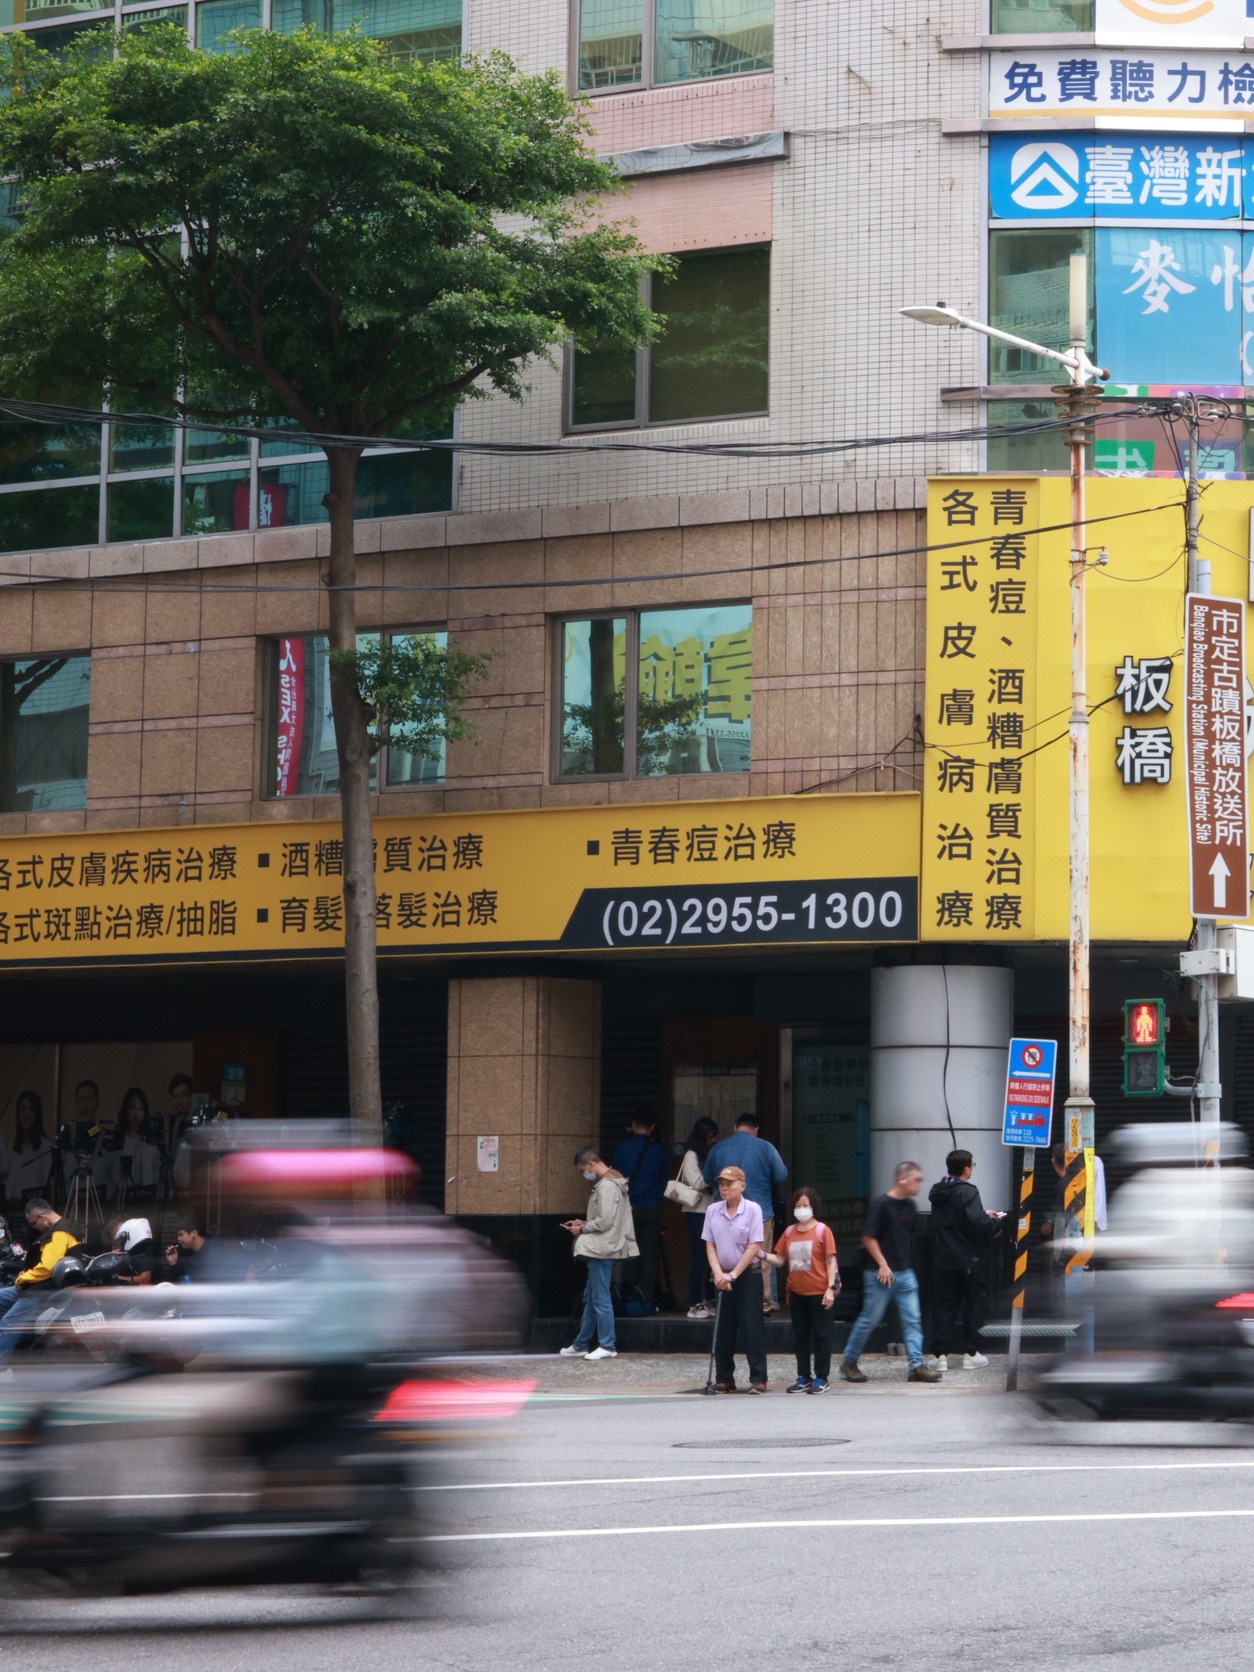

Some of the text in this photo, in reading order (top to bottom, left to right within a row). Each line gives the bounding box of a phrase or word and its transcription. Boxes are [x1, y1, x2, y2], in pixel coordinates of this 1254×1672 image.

[936, 489, 979, 928] 各式皮膚病治療
[985, 489, 1028, 931] 青春痘、酒糟膚質治療
[1115, 655, 1173, 785] 板橋
[1188, 605, 1212, 845] Banqiao Broadcasting Station (Municipal Historic Site)
[1210, 608, 1244, 847] 市定古蹟板橋放送所
[280, 832, 484, 878] 酒糟質治療
[602, 890, 902, 946] (02)2955-1300
[611, 820, 797, 866] 青春痘治療
